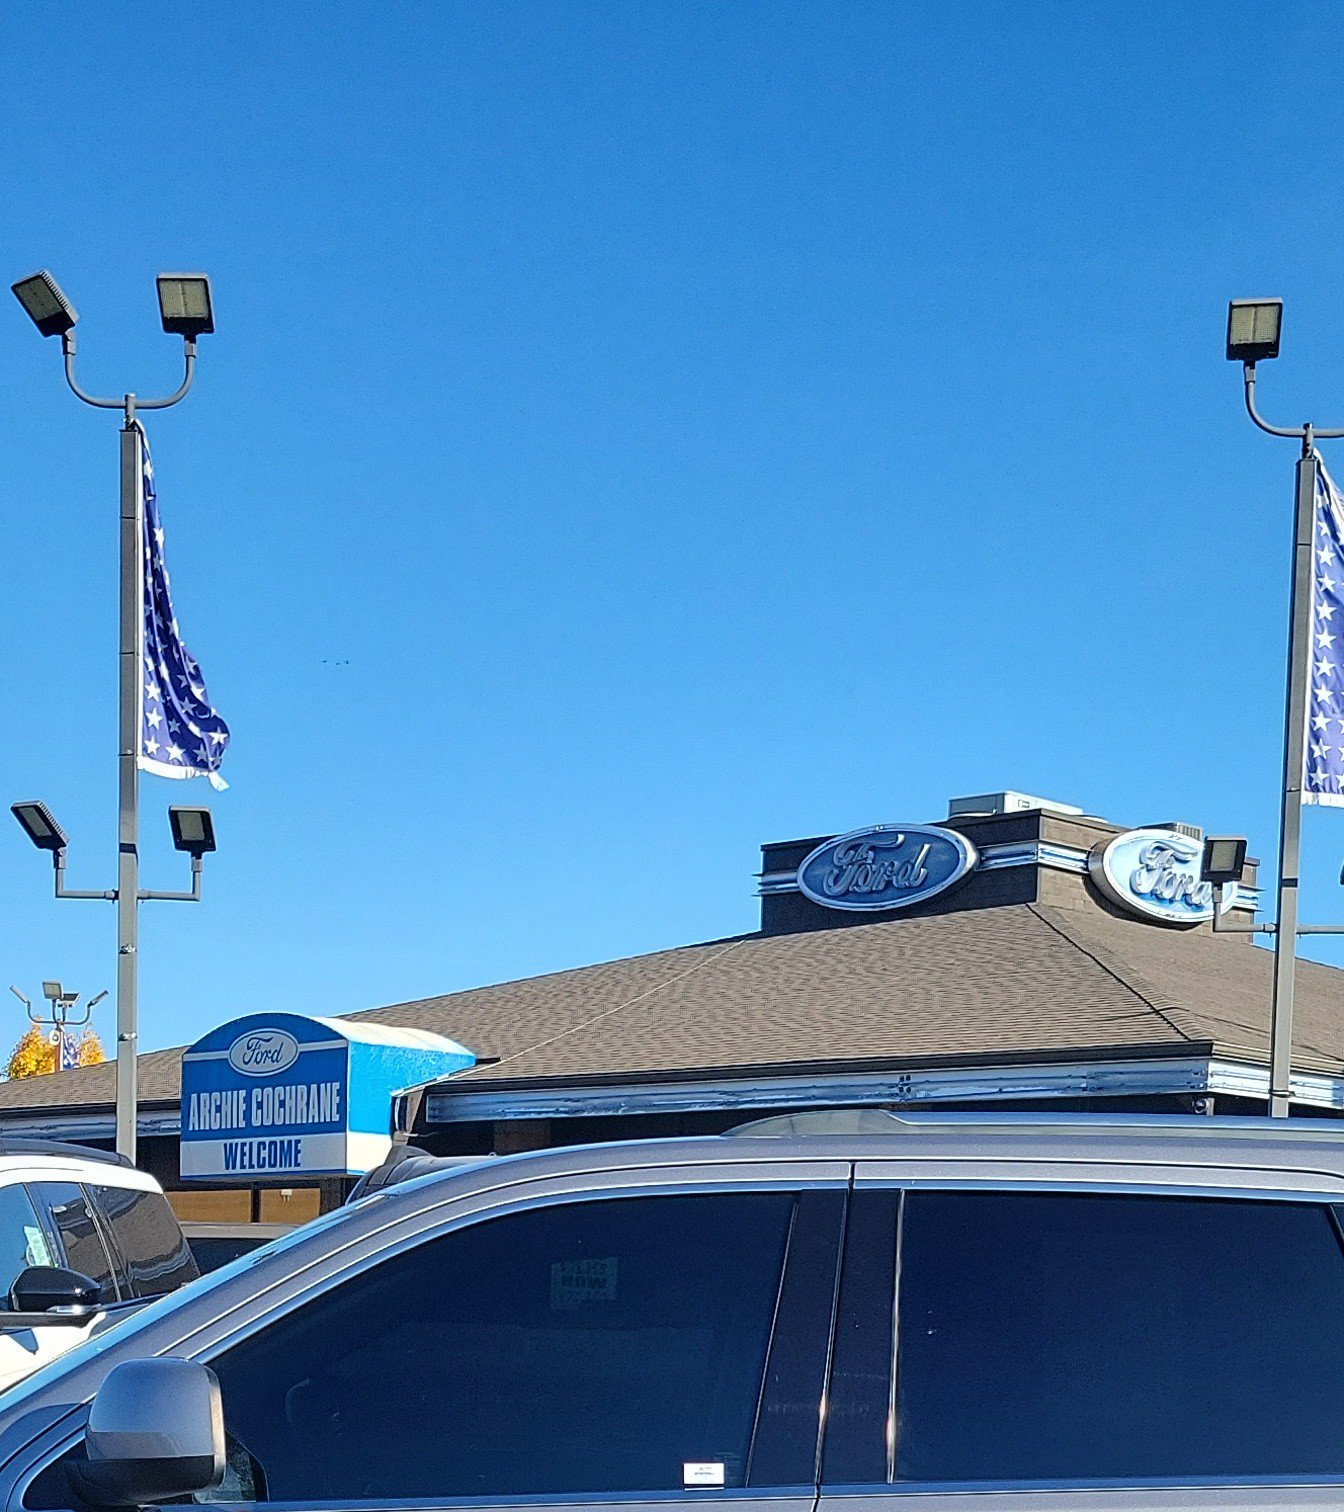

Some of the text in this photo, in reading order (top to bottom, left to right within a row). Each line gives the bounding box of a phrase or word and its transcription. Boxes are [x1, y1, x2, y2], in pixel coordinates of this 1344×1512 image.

[823, 834, 931, 896] Ford
[242, 1036, 284, 1065] Ford
[188, 1082, 341, 1131] ARCHIE COCHRANE
[223, 1139, 302, 1171] WELCOME
